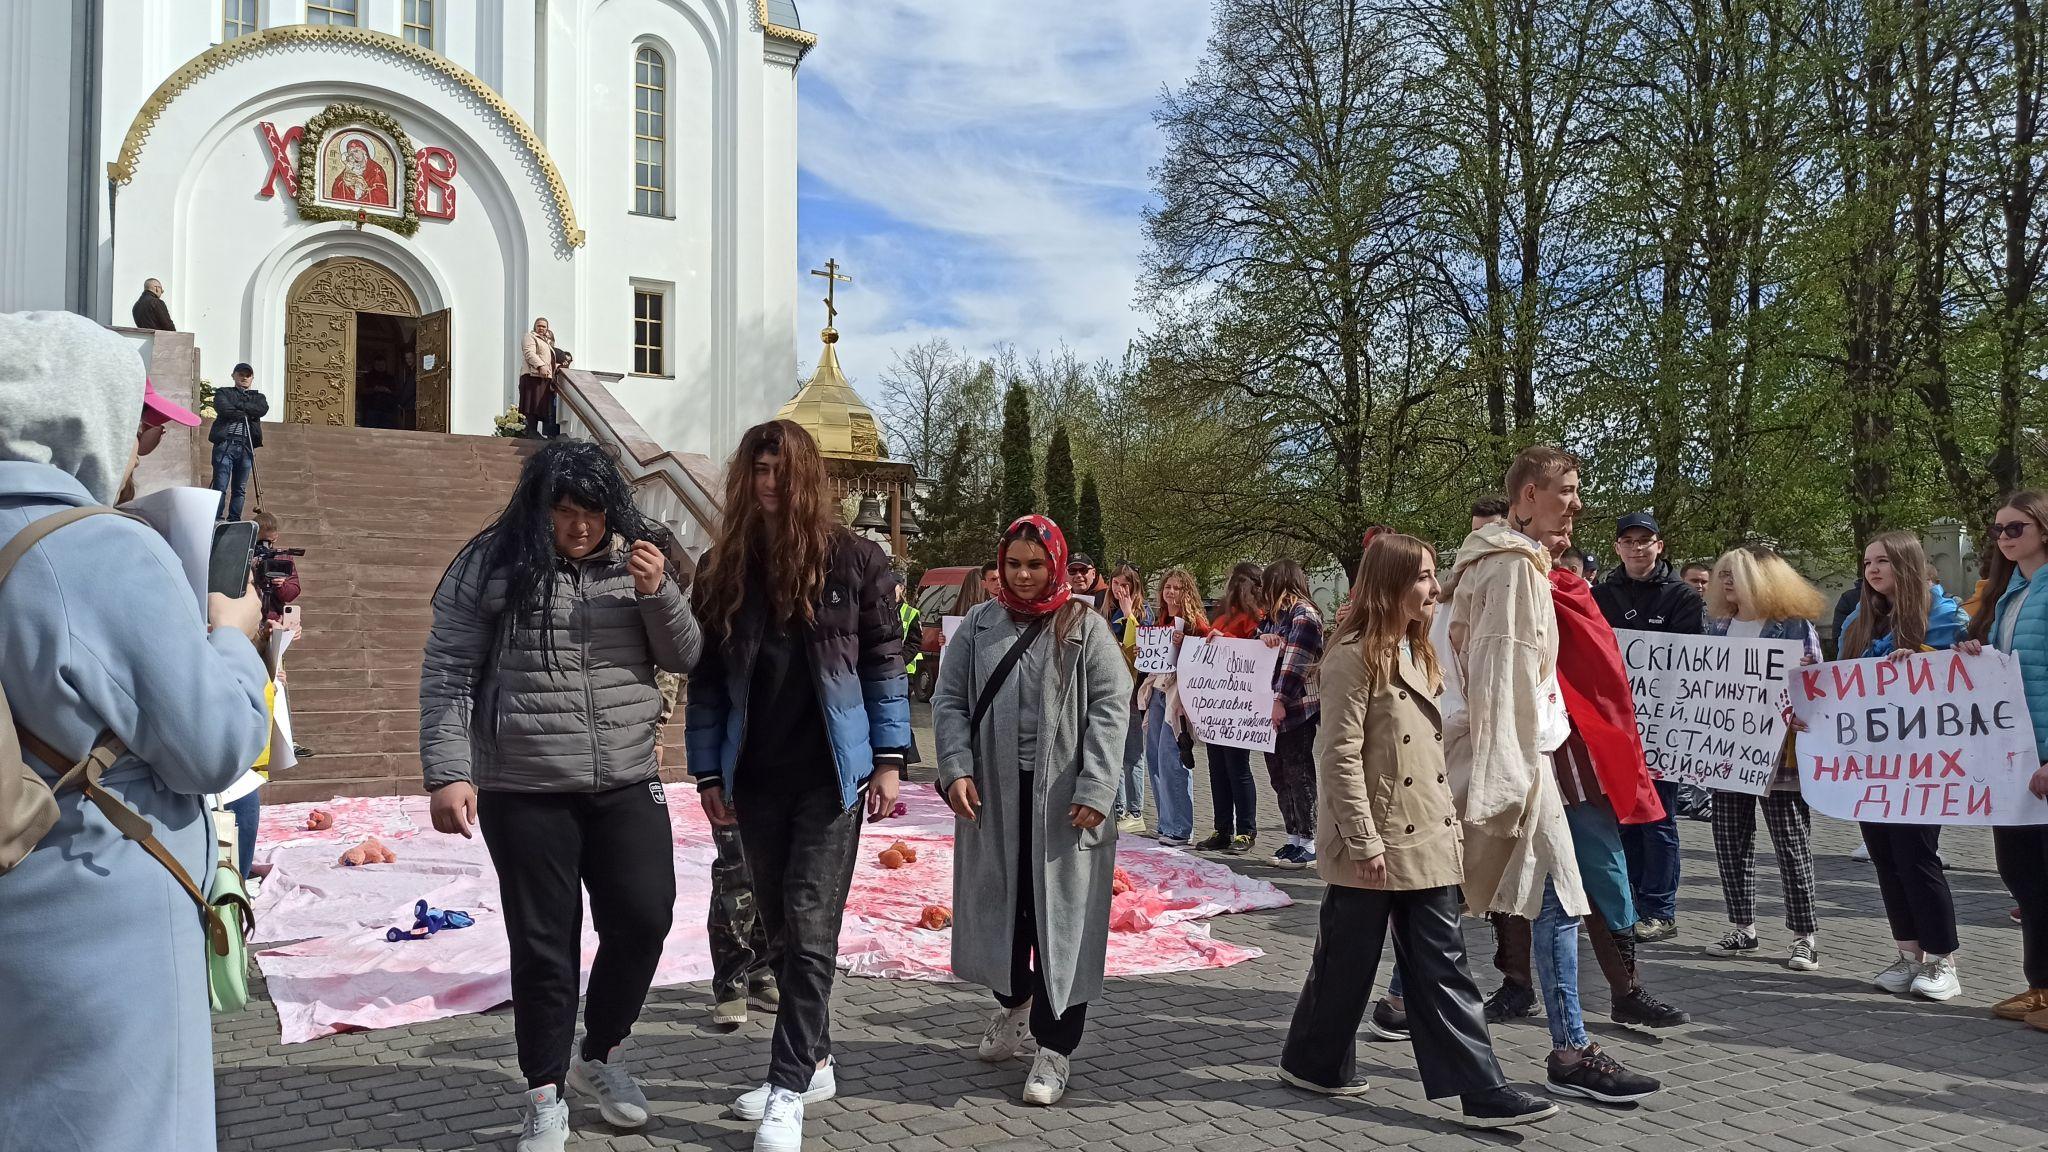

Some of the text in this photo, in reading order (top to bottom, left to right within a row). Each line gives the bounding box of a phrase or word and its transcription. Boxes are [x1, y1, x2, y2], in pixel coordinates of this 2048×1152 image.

[1744, 648, 1785, 681] ЩЕ
[1801, 653, 1975, 701] КИРИЛ
[1187, 673, 1253, 692] молитвами
[1676, 678, 1768, 704] ЗАГИНУТИ
[1191, 696, 1253, 714] прославляє
[1200, 715, 1234, 726] наших
[1694, 706, 1735, 732] ЩОБ
[1742, 711, 1774, 736] ВИ
[1836, 700, 2015, 746] ВБИВАЄ
[1644, 747, 1734, 780] ОСІЙСЬКУ
[1813, 748, 1967, 782] НАШИХ
[1853, 776, 1992, 819] ДІТЕЙ
